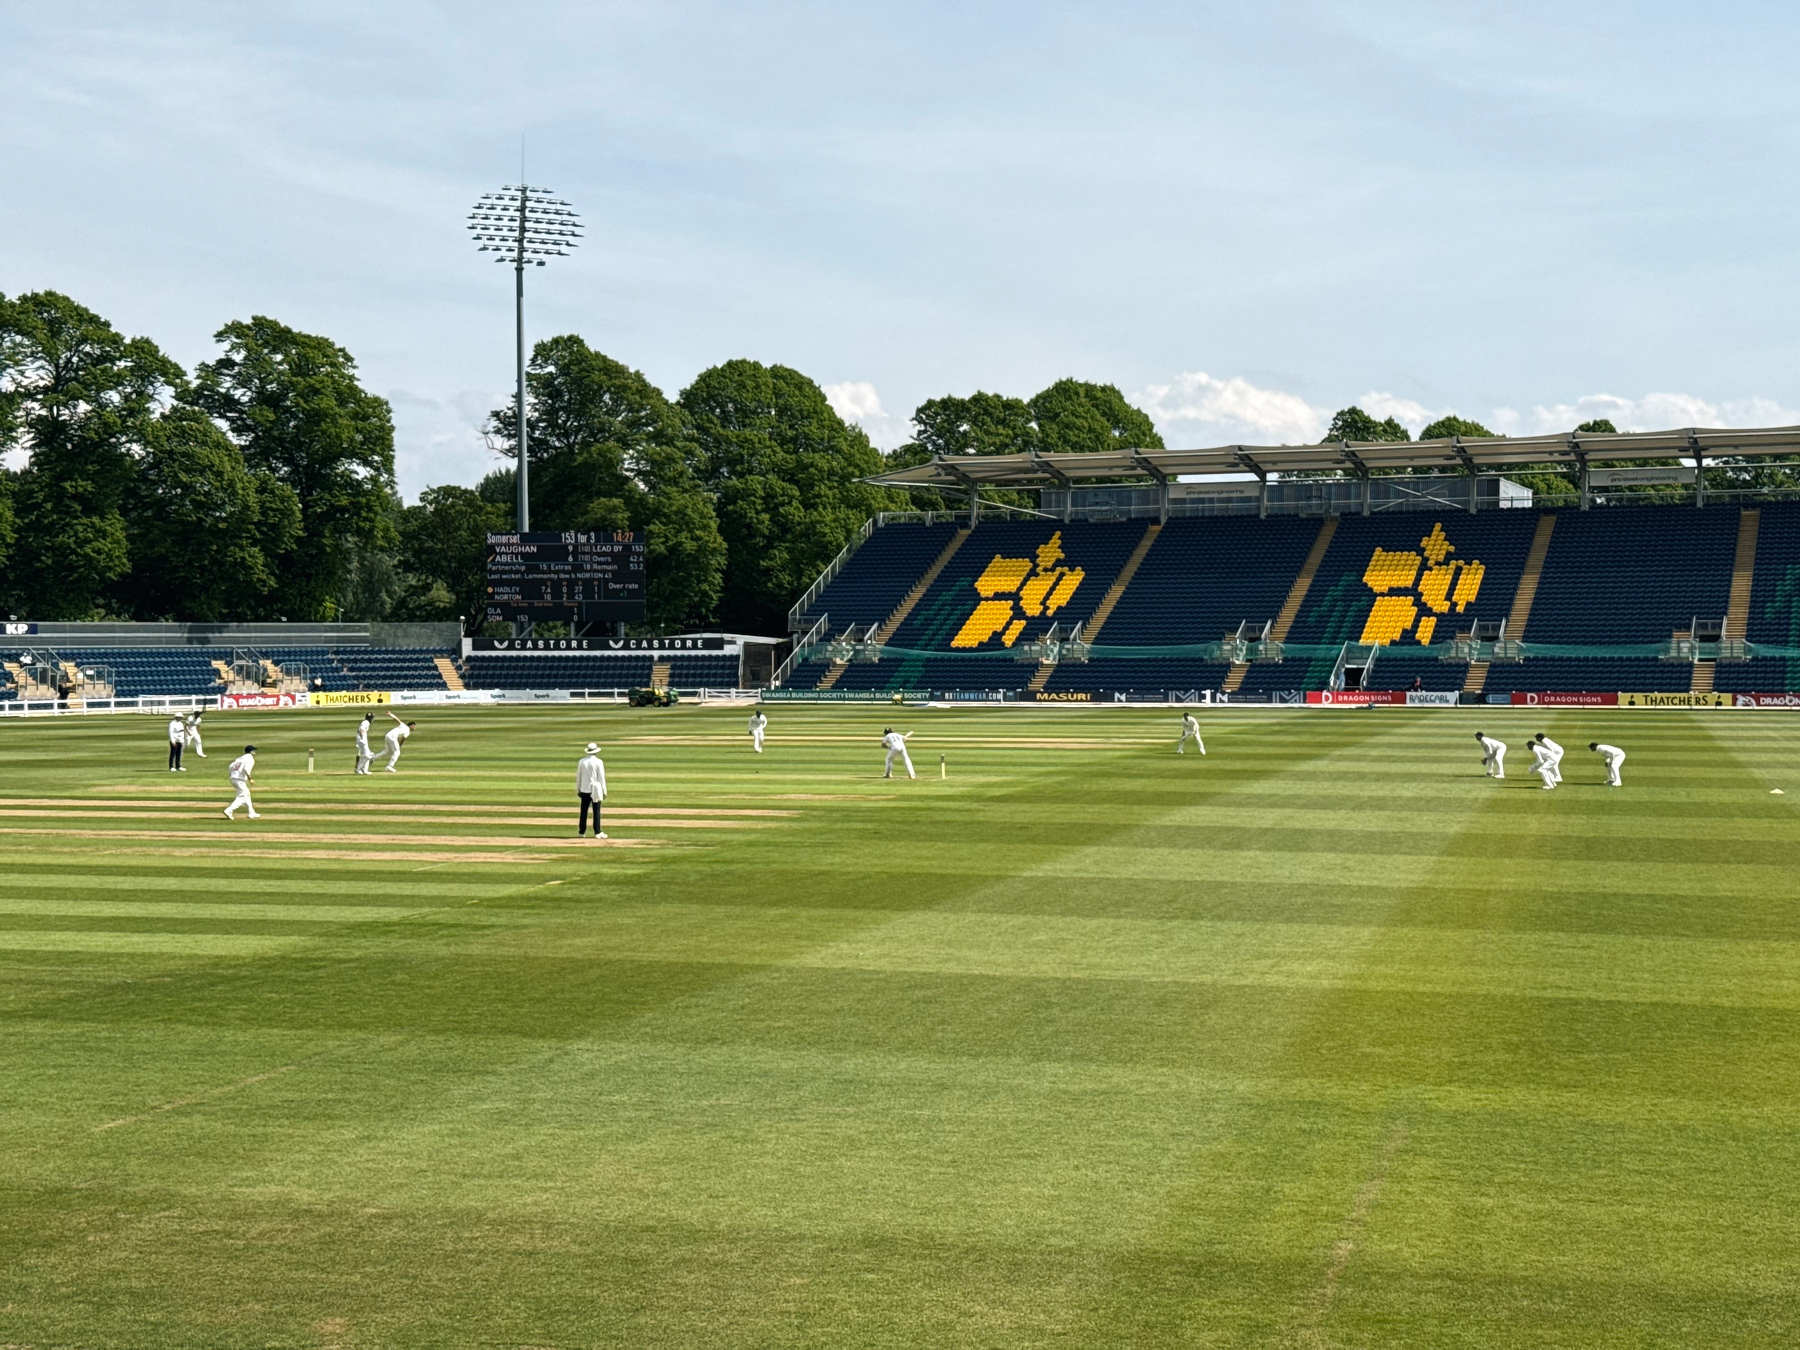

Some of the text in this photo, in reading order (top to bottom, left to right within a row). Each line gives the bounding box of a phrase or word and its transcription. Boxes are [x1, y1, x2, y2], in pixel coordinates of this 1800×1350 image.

[487, 533, 520, 543] Somerset
[561, 532, 595, 543] 153 for 3
[613, 532, 634, 542] 14:27
[515, 640, 588, 648] CASTORE
[630, 640, 703, 648] CASTORE
[325, 693, 372, 704] THATCHERS
[1643, 695, 1708, 706] THATCHERS
